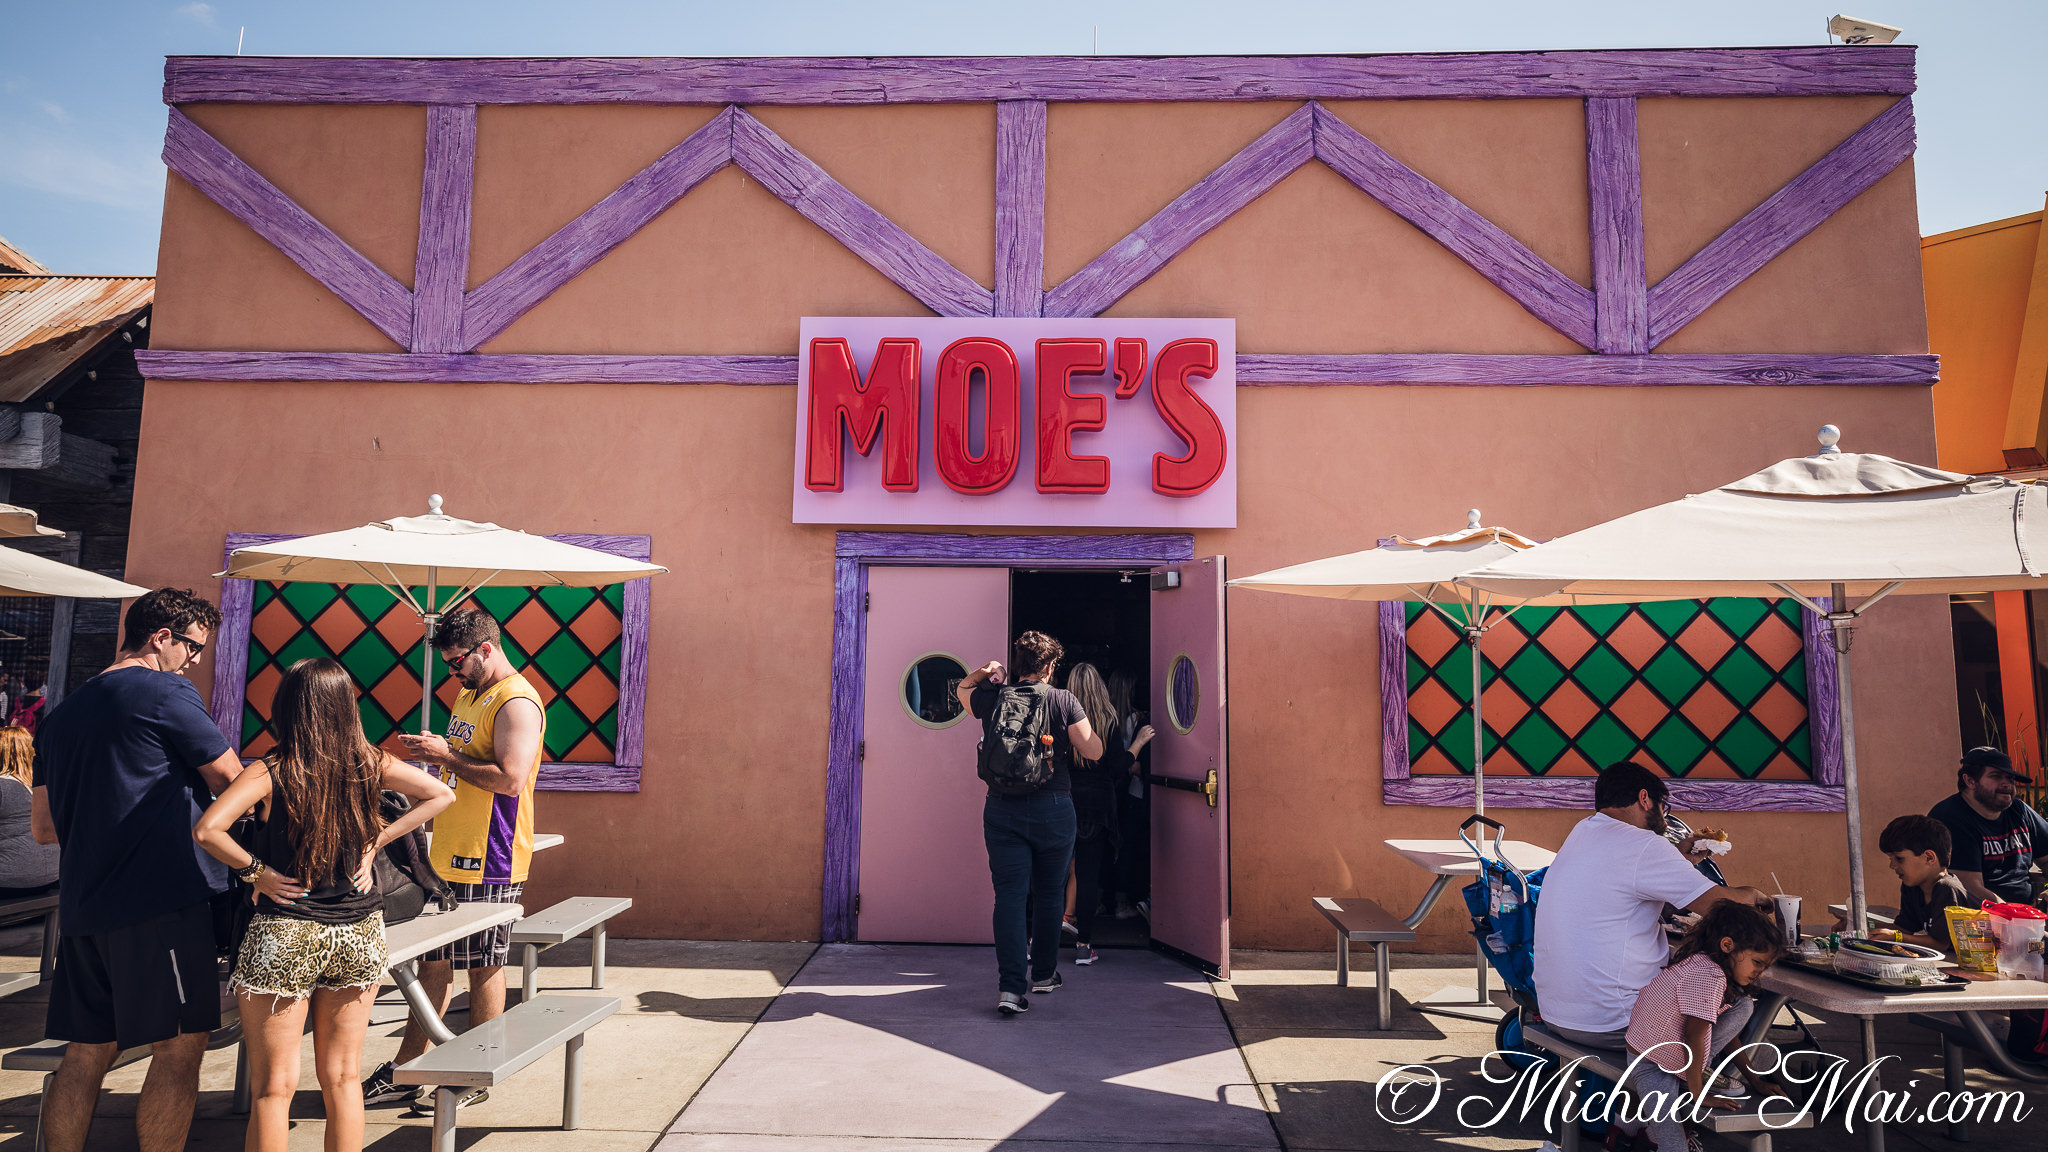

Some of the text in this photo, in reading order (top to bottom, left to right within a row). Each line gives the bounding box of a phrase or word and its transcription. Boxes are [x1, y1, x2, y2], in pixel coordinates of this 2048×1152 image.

[804, 336, 1228, 498] MOE'S
[446, 714, 475, 745] LAERS
[1983, 840, 2004, 856] OLD
